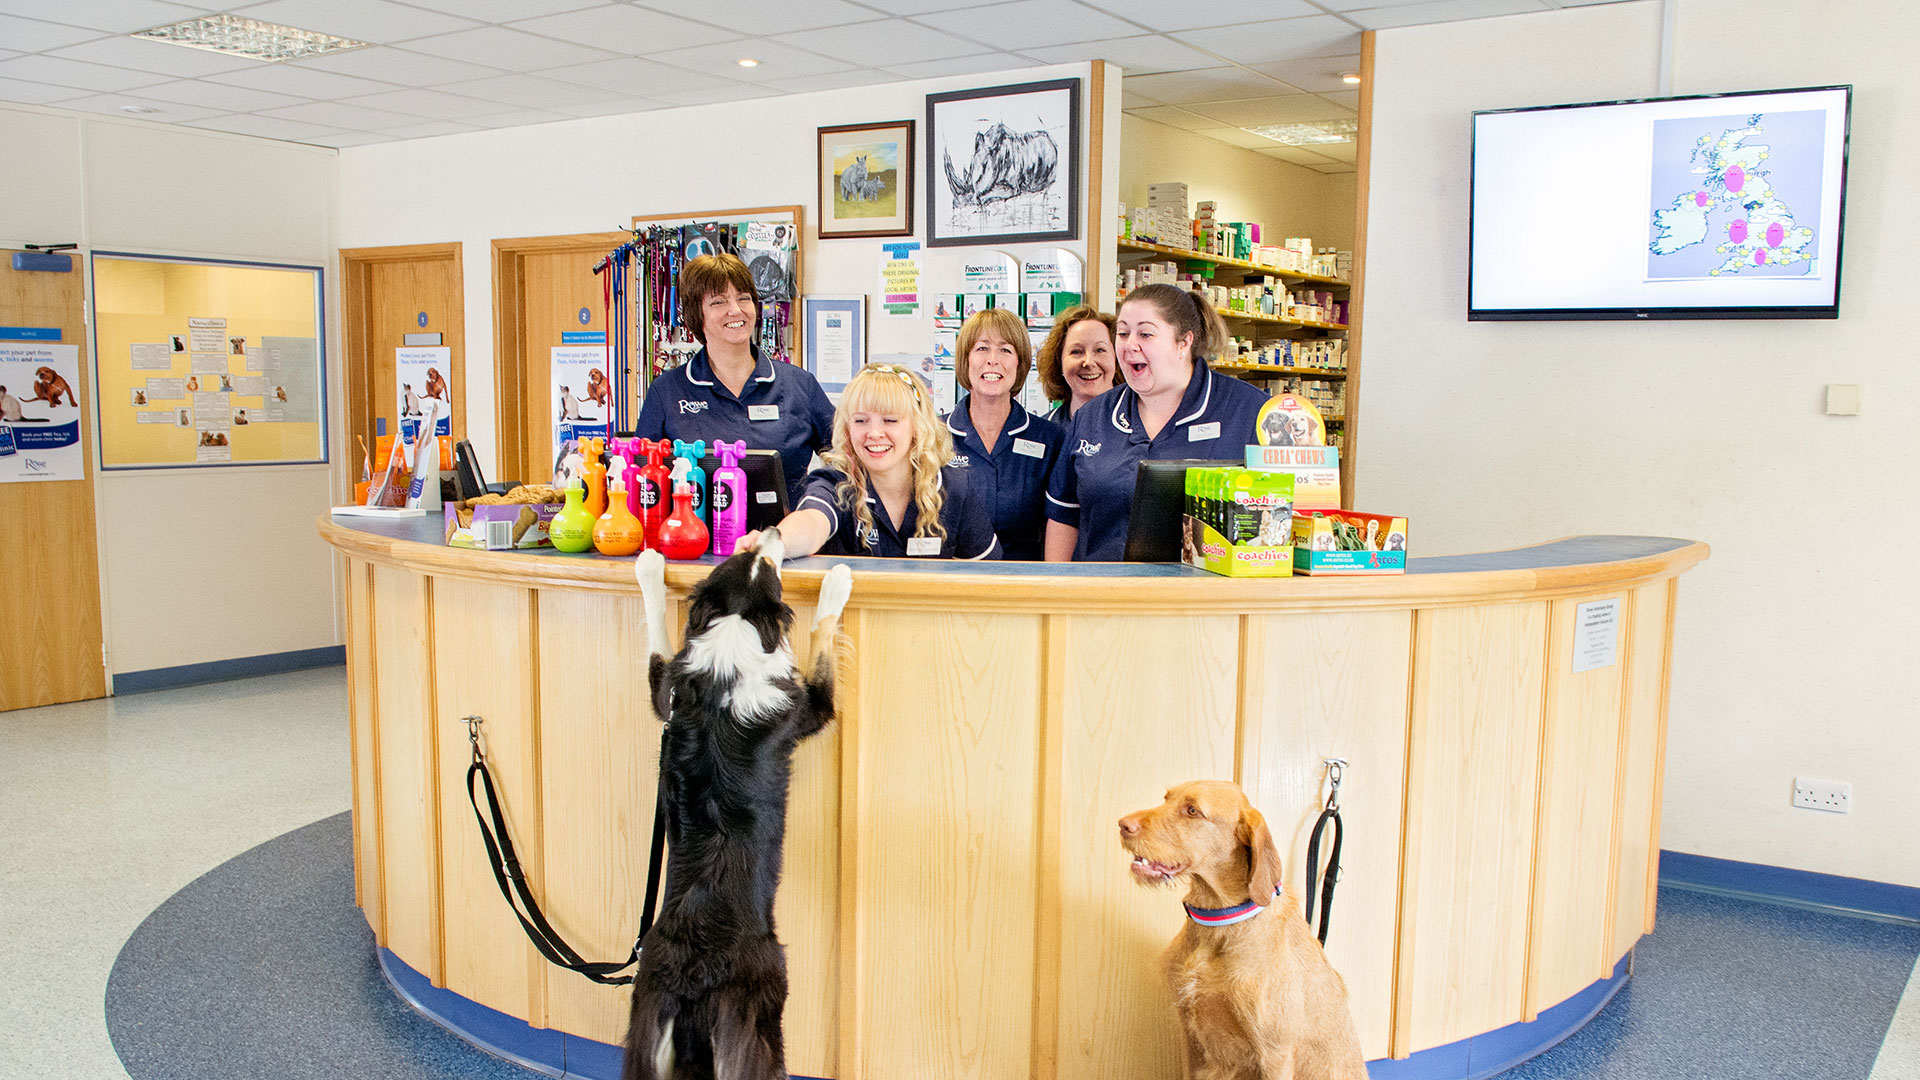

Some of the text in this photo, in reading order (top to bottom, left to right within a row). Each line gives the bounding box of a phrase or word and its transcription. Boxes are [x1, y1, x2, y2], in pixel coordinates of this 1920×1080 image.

[964, 264, 994, 273] FRONTLINE
[1025, 262, 1056, 271] FRONTLINE
[582, 312, 588, 320] 2
[678, 399, 709, 414] Rowe
[1076, 439, 1102, 457] Rowe
[1263, 449, 1326, 465] CEREA CHEWS
[25, 458, 47, 472] Rowe
[1235, 496, 1286, 505] coachies
[1237, 550, 1289, 561] coachies
[1368, 552, 1398, 569] Antos
